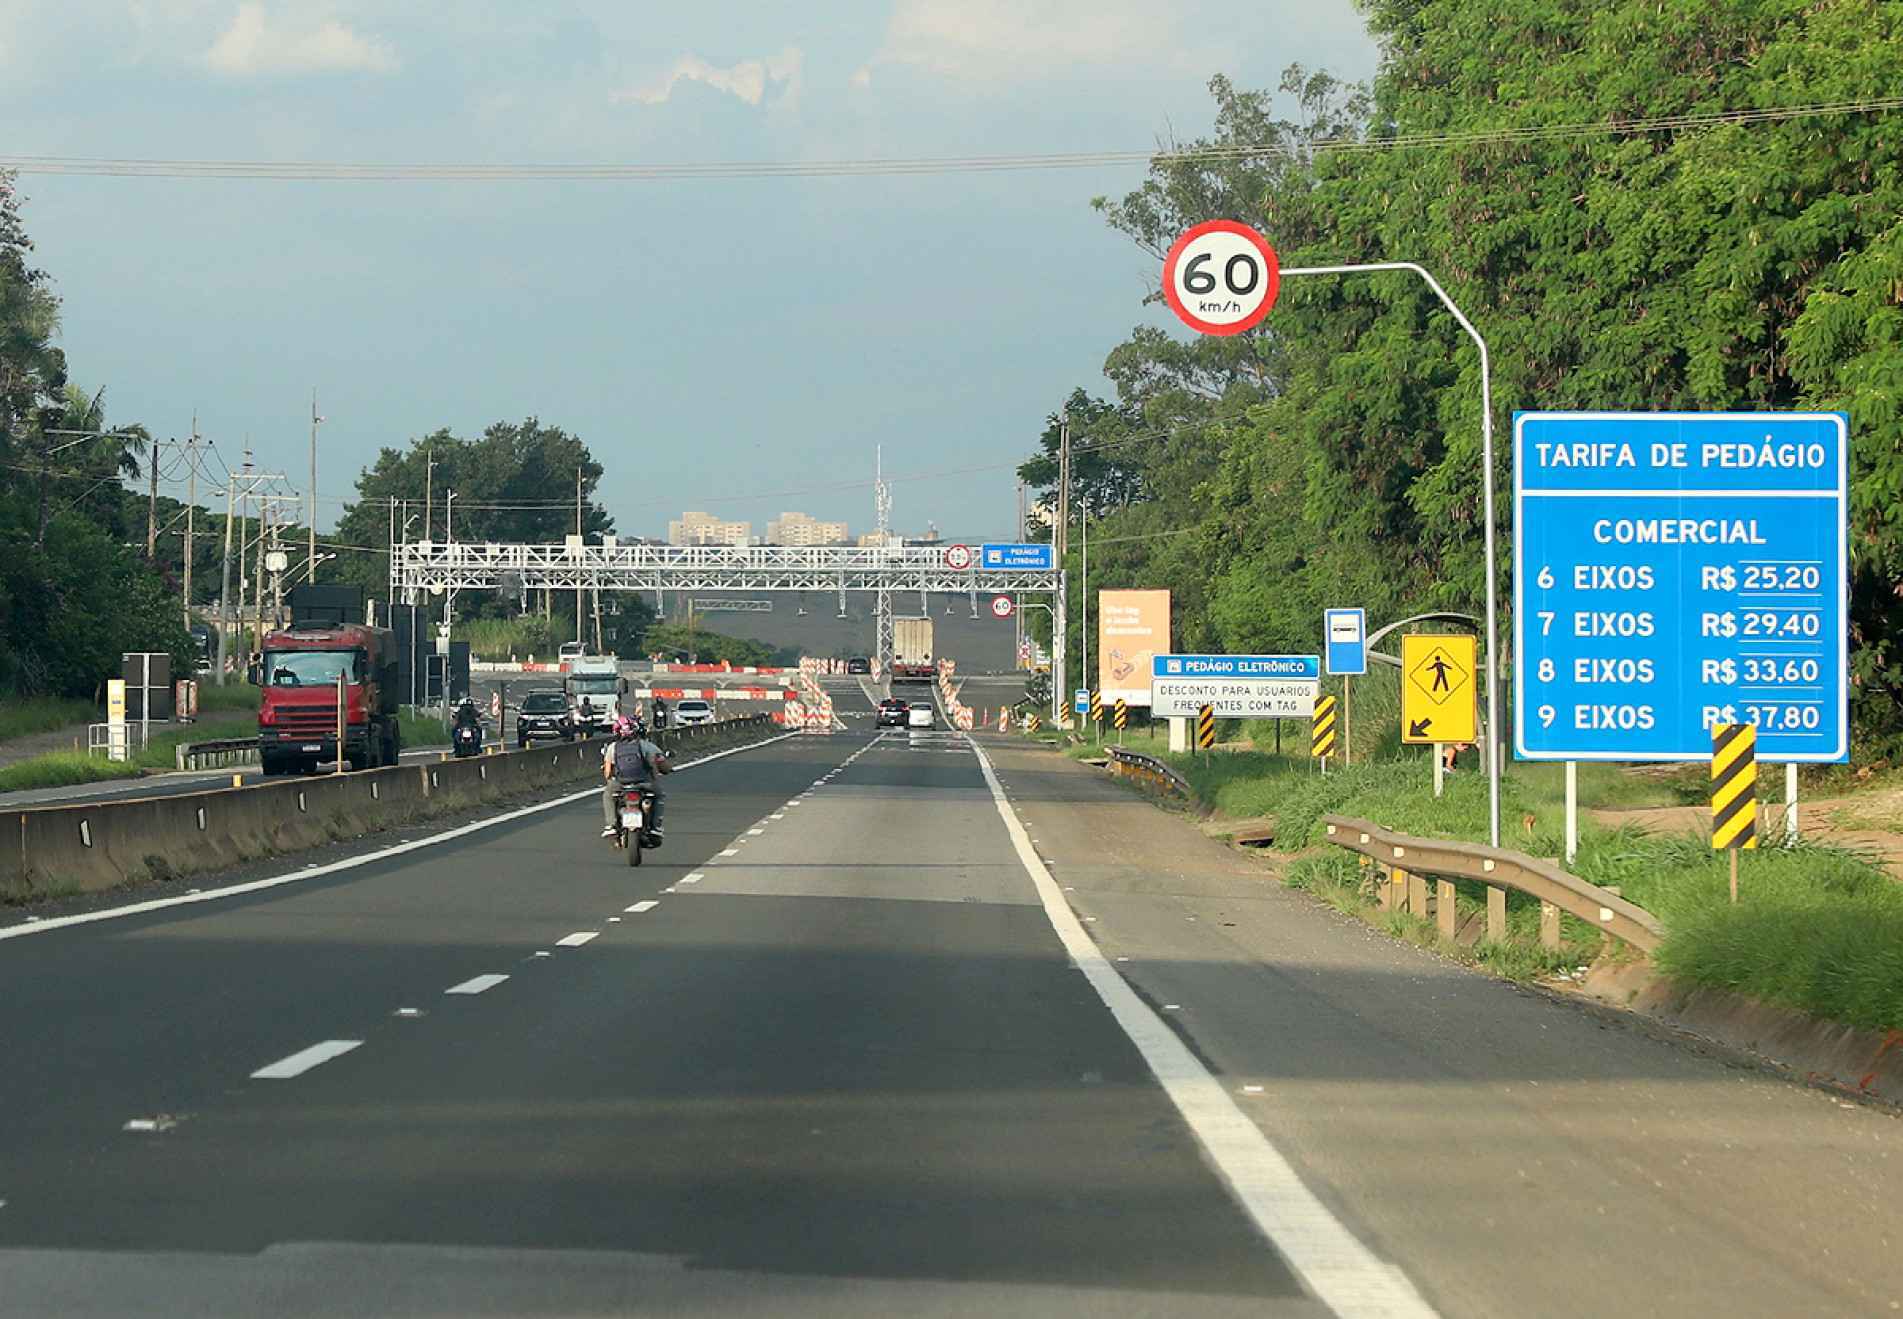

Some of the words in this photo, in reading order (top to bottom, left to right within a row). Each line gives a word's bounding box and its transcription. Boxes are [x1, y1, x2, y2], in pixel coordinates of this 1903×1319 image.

[1183, 253, 1258, 295] 60
[1199, 301, 1241, 312] km/h
[1536, 444, 1635, 467] TARIFA
[1652, 444, 1687, 467] DE
[1702, 435, 1825, 467] PEDÁGIO
[1594, 520, 1766, 544] COMERCIAL
[1538, 566, 1555, 589] 6
[1574, 566, 1654, 589] EIXOS
[1702, 566, 1738, 591] R$
[1743, 566, 1820, 589] 25,20
[1538, 612, 1555, 635] 7
[1574, 612, 1654, 636] EIXOS
[1702, 612, 1738, 637] R$
[1743, 613, 1820, 636] 29,40
[1186, 658, 1233, 672] PEDÁGIO
[1239, 660, 1305, 672] ELETRÔNICO
[1538, 659, 1555, 682] 8
[1574, 659, 1654, 682] EIXOS
[1702, 658, 1738, 684] R$
[1743, 660, 1819, 683] 33,60
[1161, 686, 1217, 696] DESCONTO
[1223, 686, 1250, 696] PARA
[1248, 700, 1271, 710] COM
[1278, 700, 1297, 710] TAG
[1538, 705, 1555, 728] 9
[1575, 705, 1655, 729] EIXOS
[1702, 704, 1738, 730] R$
[1743, 706, 1820, 729] 37,80
